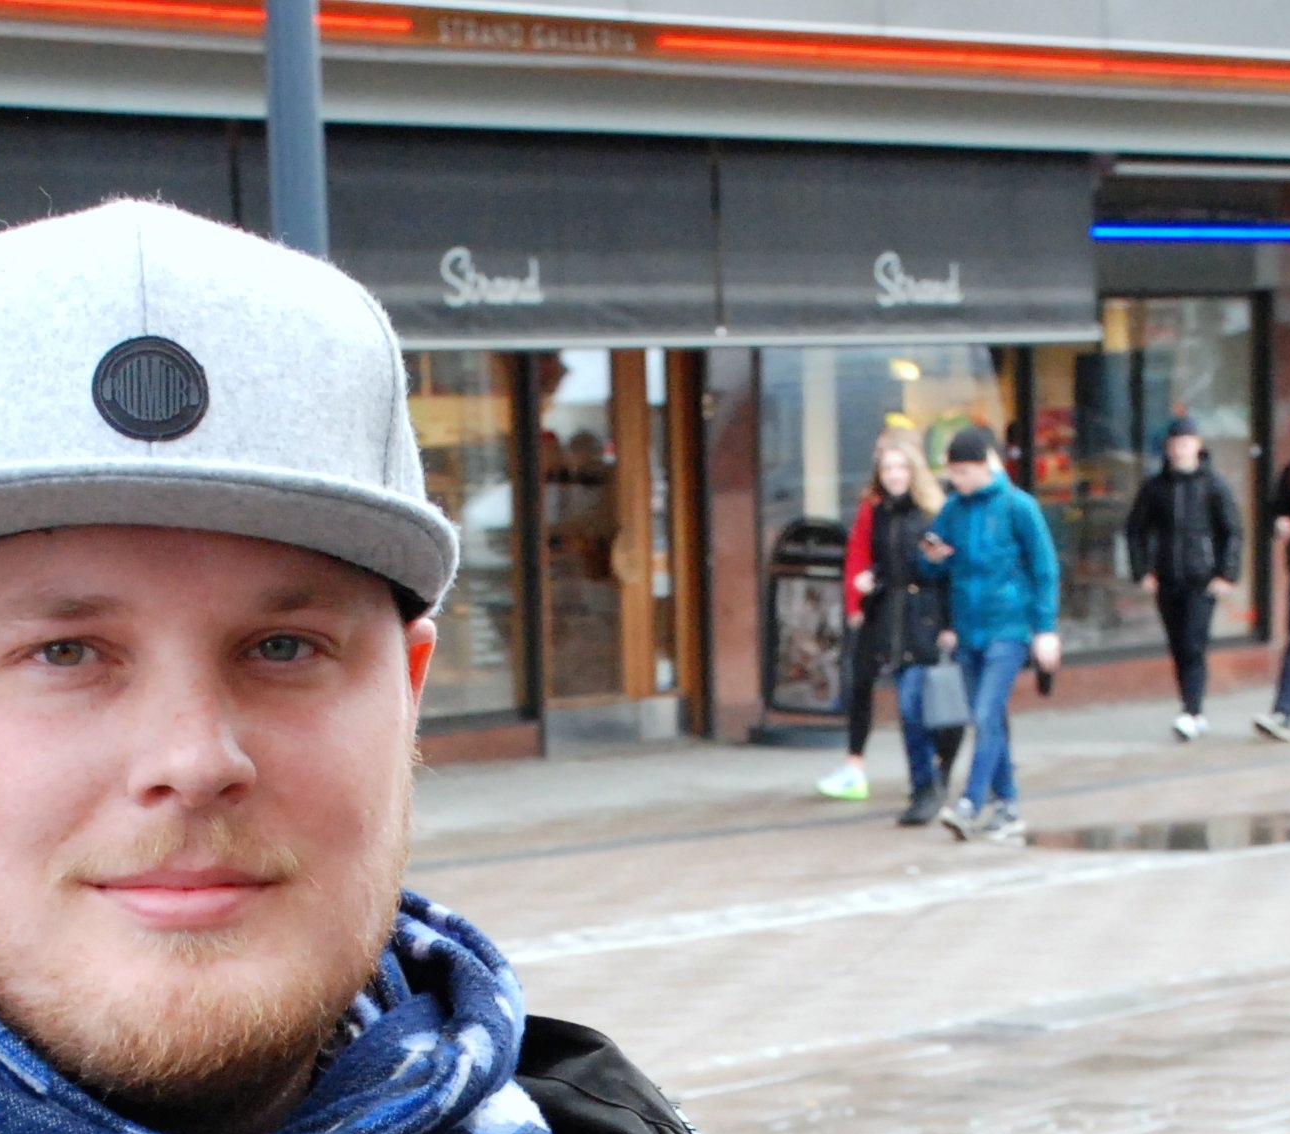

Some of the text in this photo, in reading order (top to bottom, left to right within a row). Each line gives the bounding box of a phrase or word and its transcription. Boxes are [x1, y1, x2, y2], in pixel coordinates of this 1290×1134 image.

[437, 16, 524, 48] STRAND
[439, 245, 546, 307] Strand
[873, 250, 966, 307] Strand
